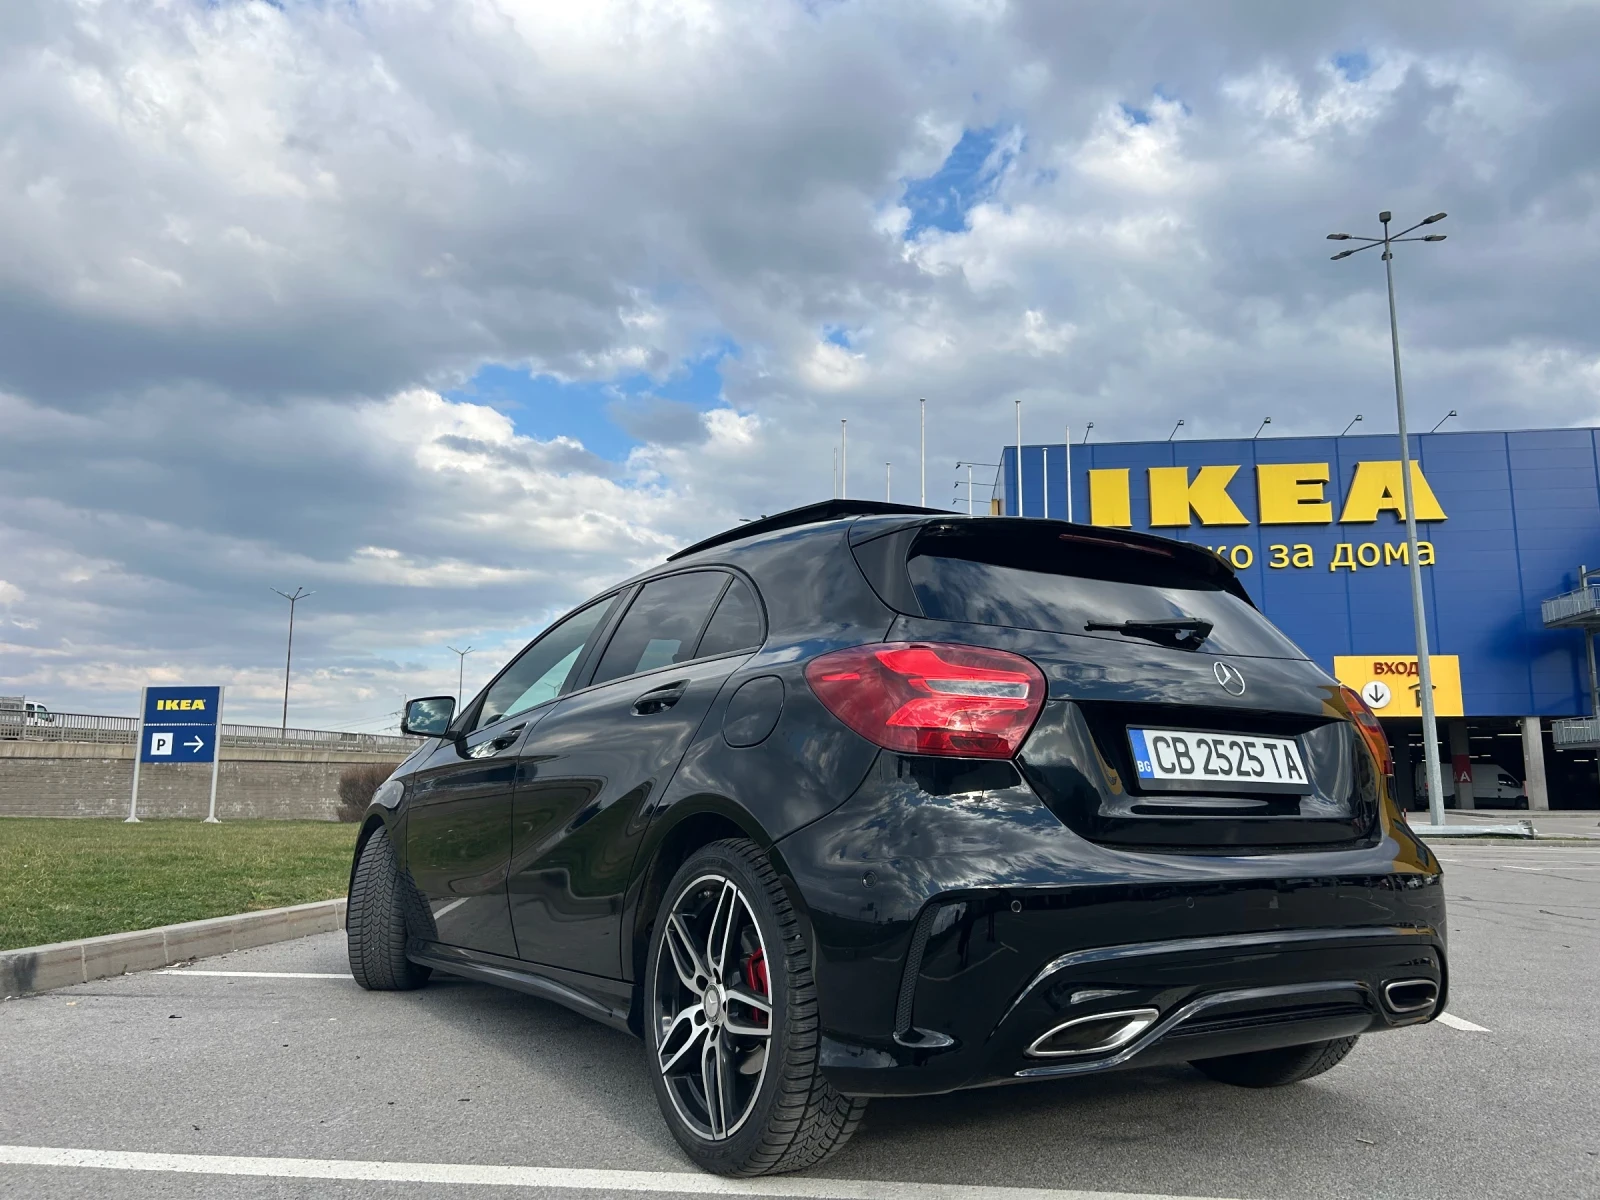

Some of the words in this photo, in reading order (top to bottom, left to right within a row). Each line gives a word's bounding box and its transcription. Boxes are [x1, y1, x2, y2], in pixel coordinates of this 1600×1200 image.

[1089, 460, 1448, 527] IKEA
[1269, 542, 1314, 568] за
[1329, 540, 1436, 572] дома
[1373, 661, 1420, 677] ВХОД
[156, 699, 206, 711] IKEA
[156, 738, 166, 751] P
[1152, 736, 1195, 774] CB
[1196, 738, 1265, 778] 2525
[1262, 742, 1303, 780] TA
[1136, 760, 1152, 773] BG
[1460, 771, 1471, 782] A
